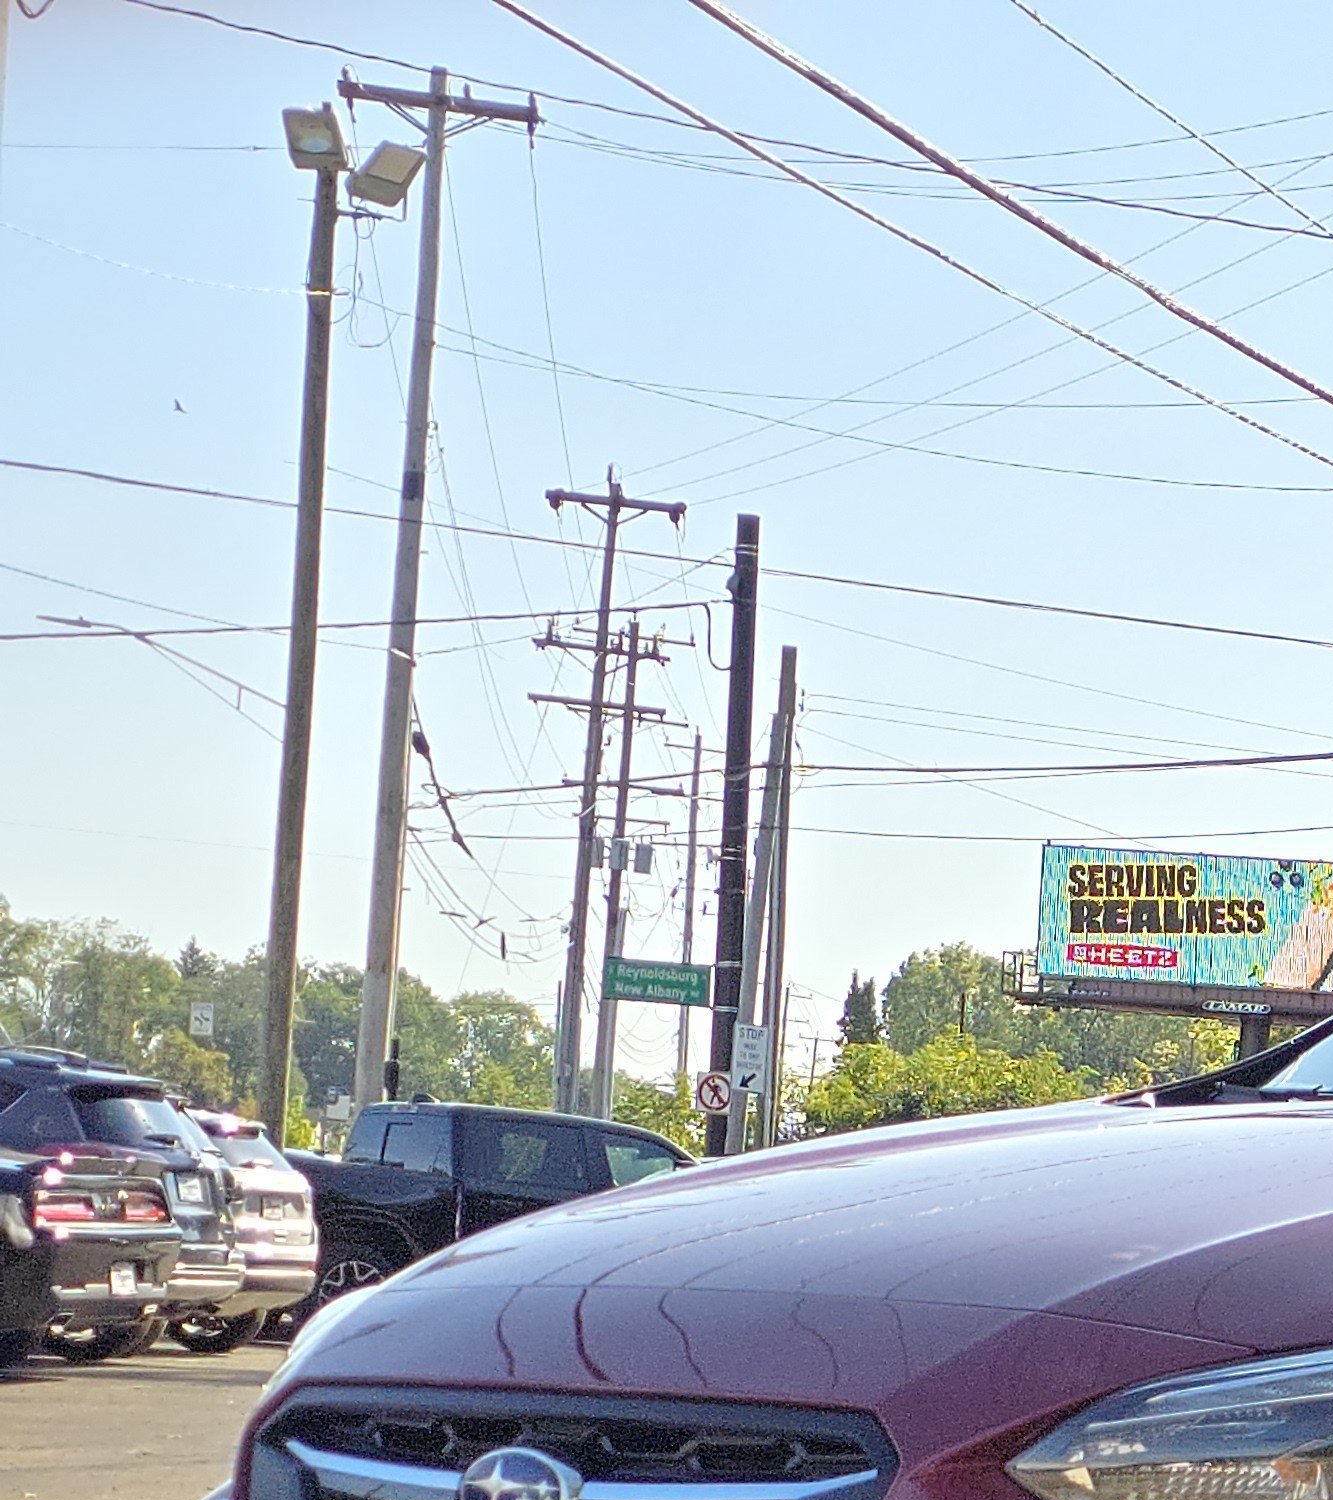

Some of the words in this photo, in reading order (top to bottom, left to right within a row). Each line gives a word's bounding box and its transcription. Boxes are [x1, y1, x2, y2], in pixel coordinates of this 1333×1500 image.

[1068, 864, 1197, 897] SERVING
[1069, 899, 1266, 934] REALNESS
[616, 963, 698, 986] Reynoldsburg
[615, 982, 642, 996] New
[645, 983, 688, 1002] Albany
